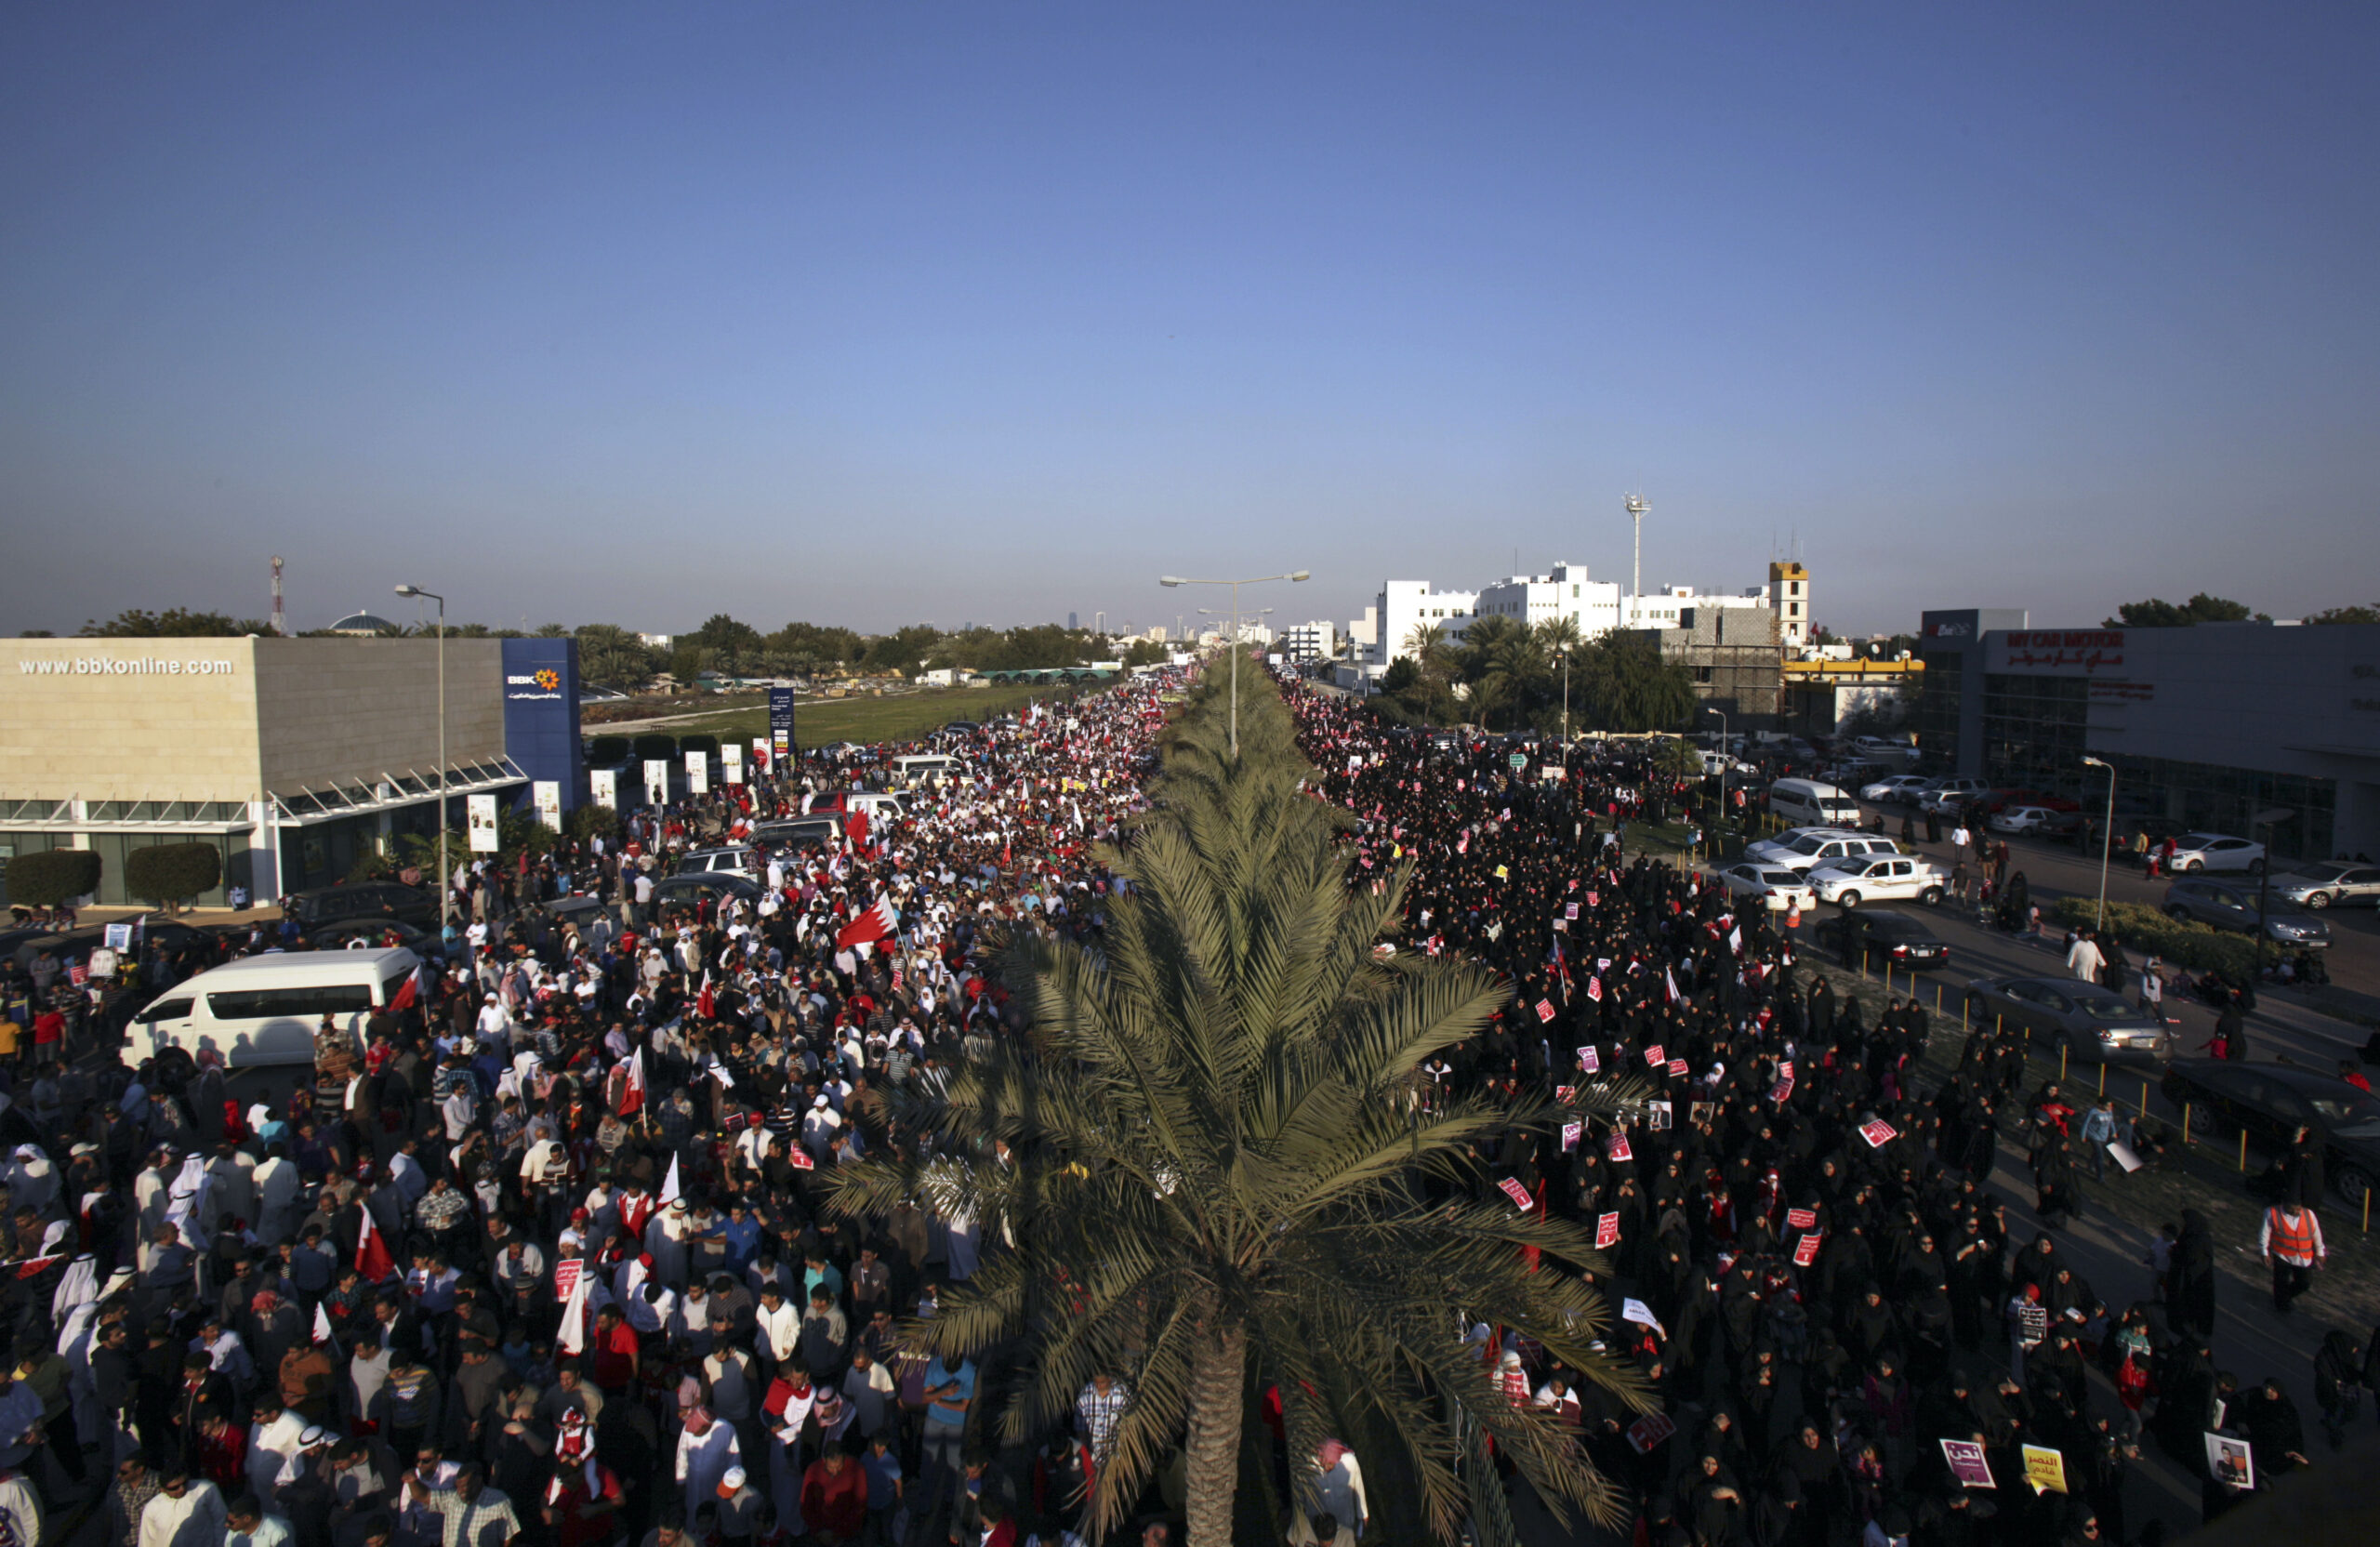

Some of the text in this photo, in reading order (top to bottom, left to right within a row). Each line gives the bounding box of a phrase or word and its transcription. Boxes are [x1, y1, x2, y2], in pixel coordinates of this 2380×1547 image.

[2007, 631, 2124, 647] MY CAR MOTOR
[19, 656, 232, 674] www.bbkonline.com
[507, 675, 536, 684] BBK
[1948, 1444, 1980, 1461] نحن
[2029, 1455, 2057, 1467] النصر
[2033, 1466, 2056, 1476] قادم
